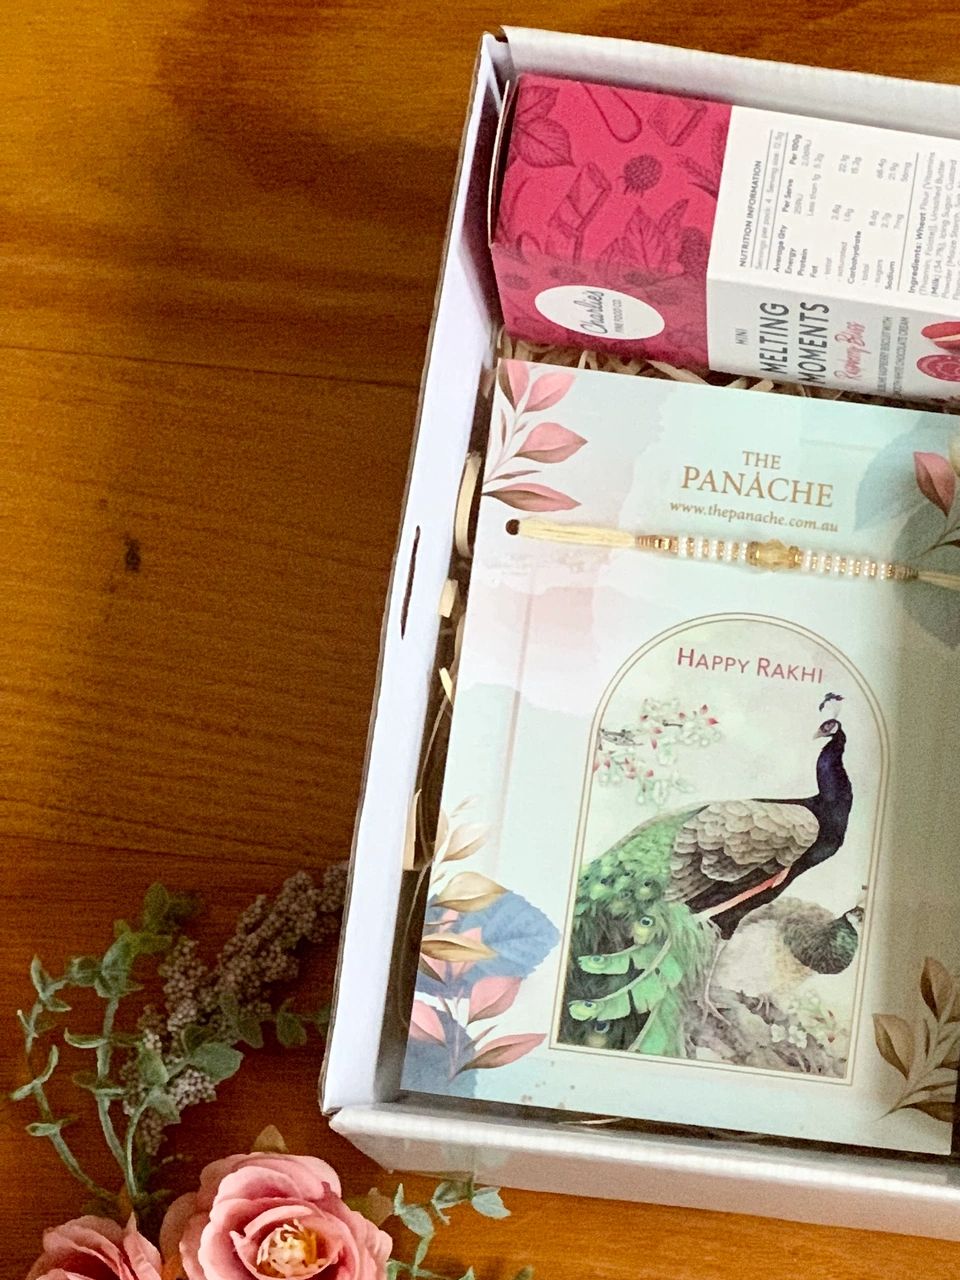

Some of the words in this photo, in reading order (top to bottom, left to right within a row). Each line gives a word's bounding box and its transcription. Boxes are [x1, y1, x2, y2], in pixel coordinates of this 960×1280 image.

[791, 133, 802, 151] 100g
[789, 152, 797, 165] Per
[784, 178, 794, 198] Serve
[739, 219, 752, 267] NUTRITION
[746, 159, 762, 218] INFORMATION
[782, 199, 790, 212] Per
[773, 240, 785, 272] Average
[785, 247, 797, 274] Energy
[797, 247, 808, 276] Protein
[847, 230, 862, 284] Carbohydrate
[907, 241, 923, 294] Ingredients:
[915, 211, 926, 240] Wheat
[810, 265, 818, 277] Fat
[885, 260, 895, 289] Sodium
[735, 328, 747, 345] MINI
[759, 302, 789, 374] MELTING
[797, 302, 829, 384] MOMENTS
[742, 450, 781, 470] THE
[670, 501, 838, 532] www.thepanache.com.au
